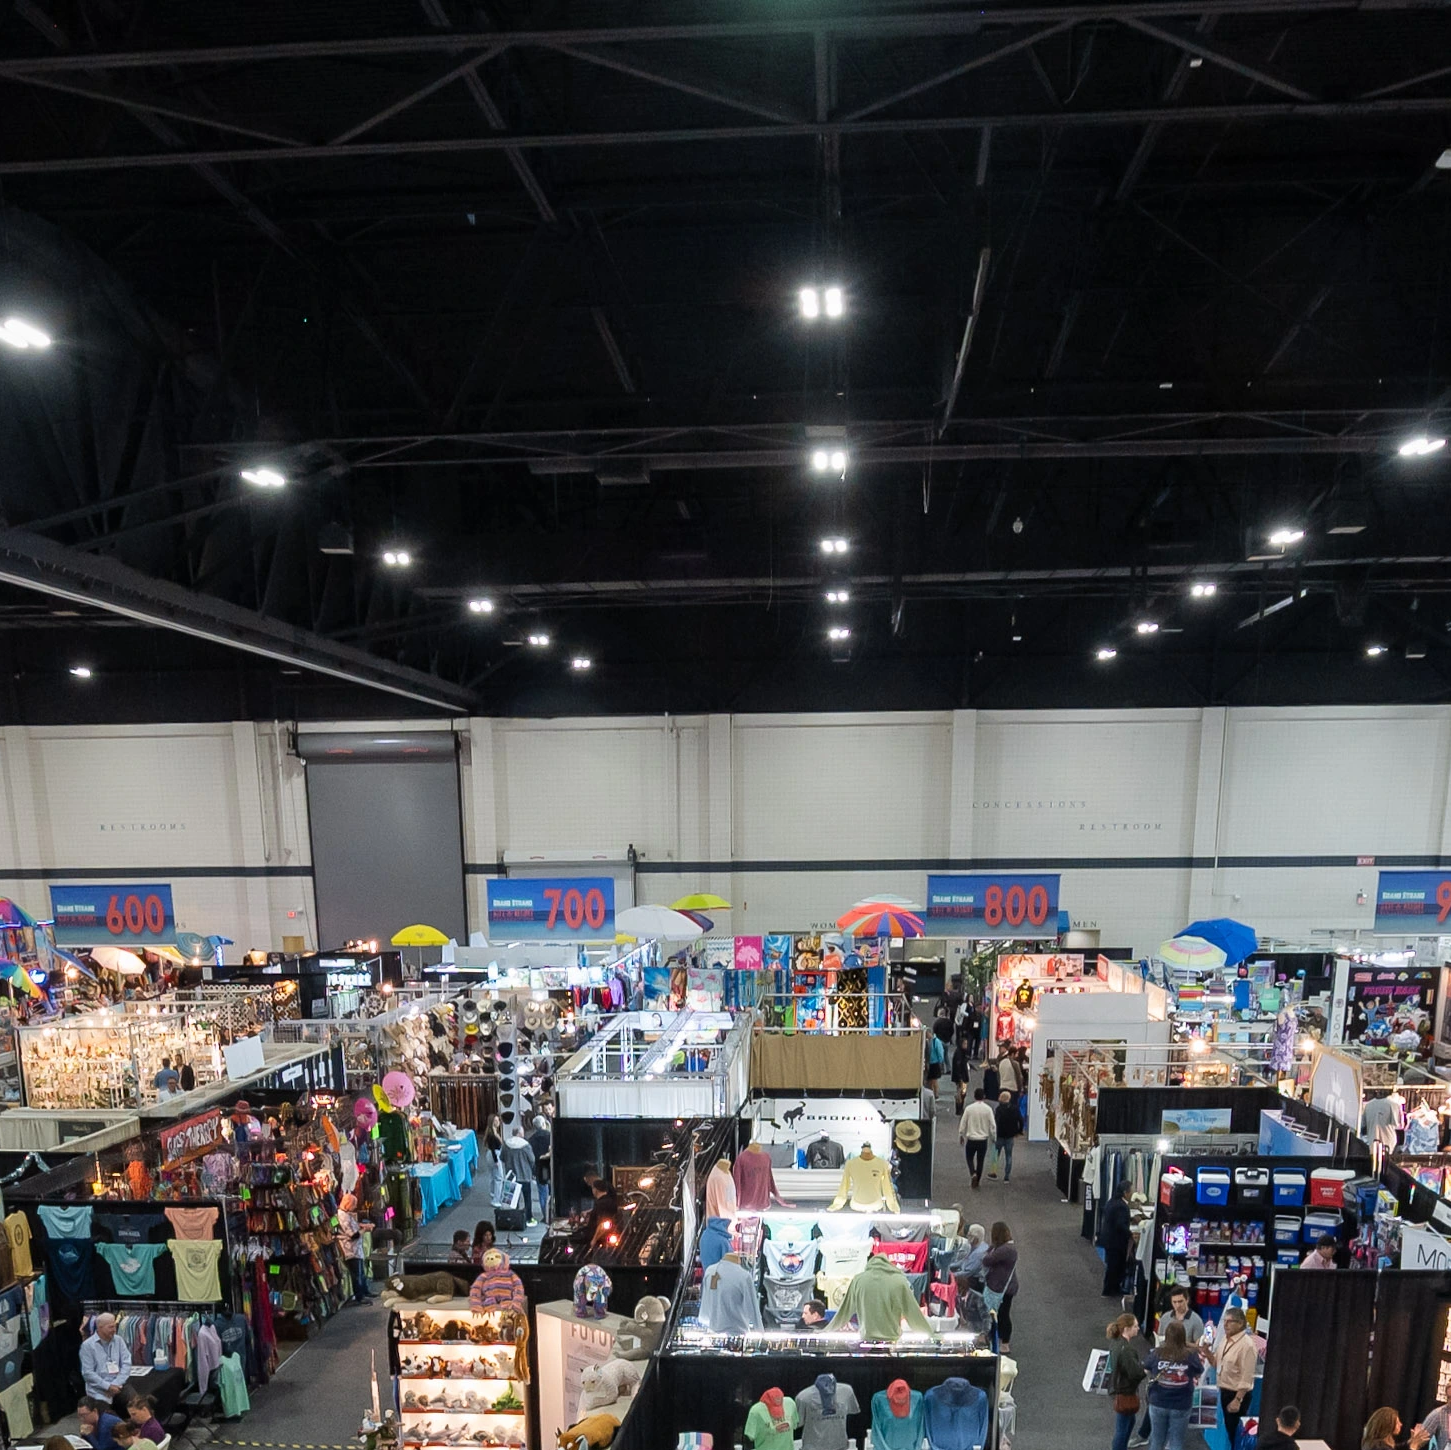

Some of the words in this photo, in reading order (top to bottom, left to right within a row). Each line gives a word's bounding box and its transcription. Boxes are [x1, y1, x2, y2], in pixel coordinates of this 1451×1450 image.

[971, 801, 1087, 809] CONCESSIONS
[100, 823, 187, 831] RESTROOMS
[1079, 823, 1162, 831] RESTROOM
[543, 888, 606, 930] 700
[984, 885, 1049, 927] 800
[106, 894, 165, 934] 600
[810, 922, 837, 930] WOM
[1072, 920, 1098, 928] MEN
[570, 1323, 616, 1347] FUTU
